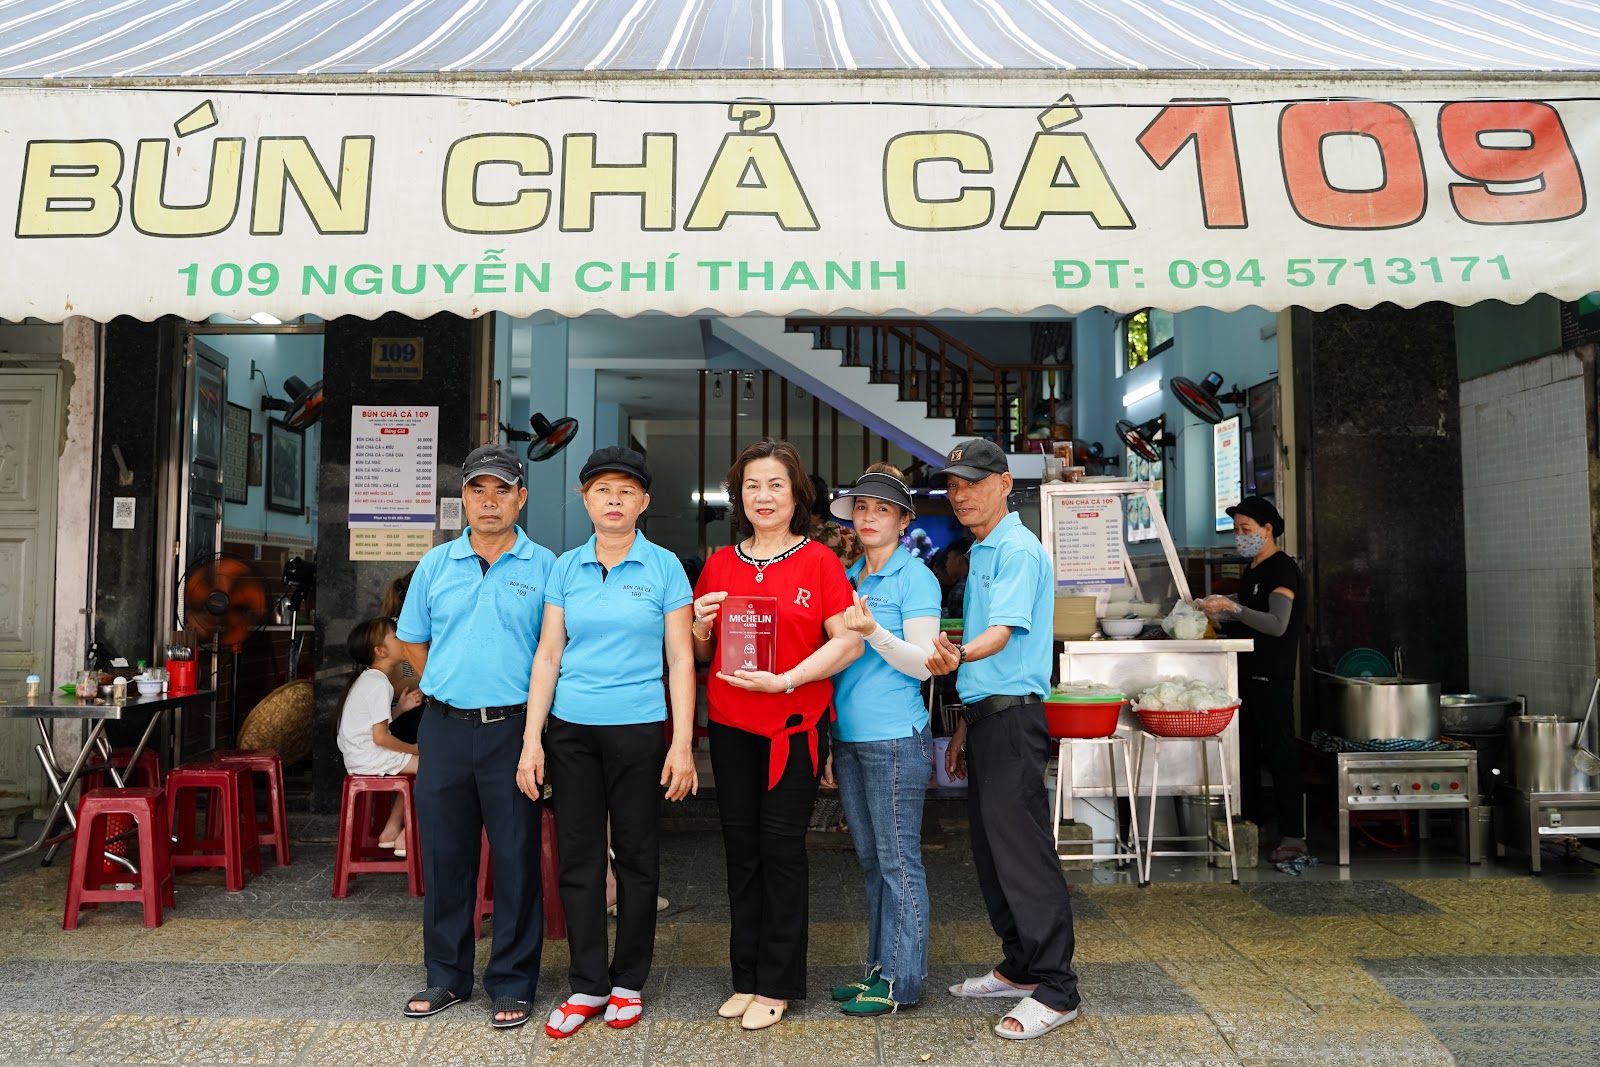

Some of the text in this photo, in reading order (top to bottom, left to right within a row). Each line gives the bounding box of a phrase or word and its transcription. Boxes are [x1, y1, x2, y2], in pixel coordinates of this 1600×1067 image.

[14, 94, 1588, 239] BÚN CHẢ CÁ 109
[177, 248, 908, 296] 109 NGUYỄN CHÍ THANH
[1052, 254, 1513, 290] ĐT: 094 5713171
[379, 343, 416, 362] 109
[362, 409, 378, 418] BÚN
[380, 409, 398, 418] CHẢ
[400, 409, 412, 418] CÁ
[516, 589, 527, 597] 109
[793, 587, 812, 609] R
[729, 615, 772, 623] MICHELIN
